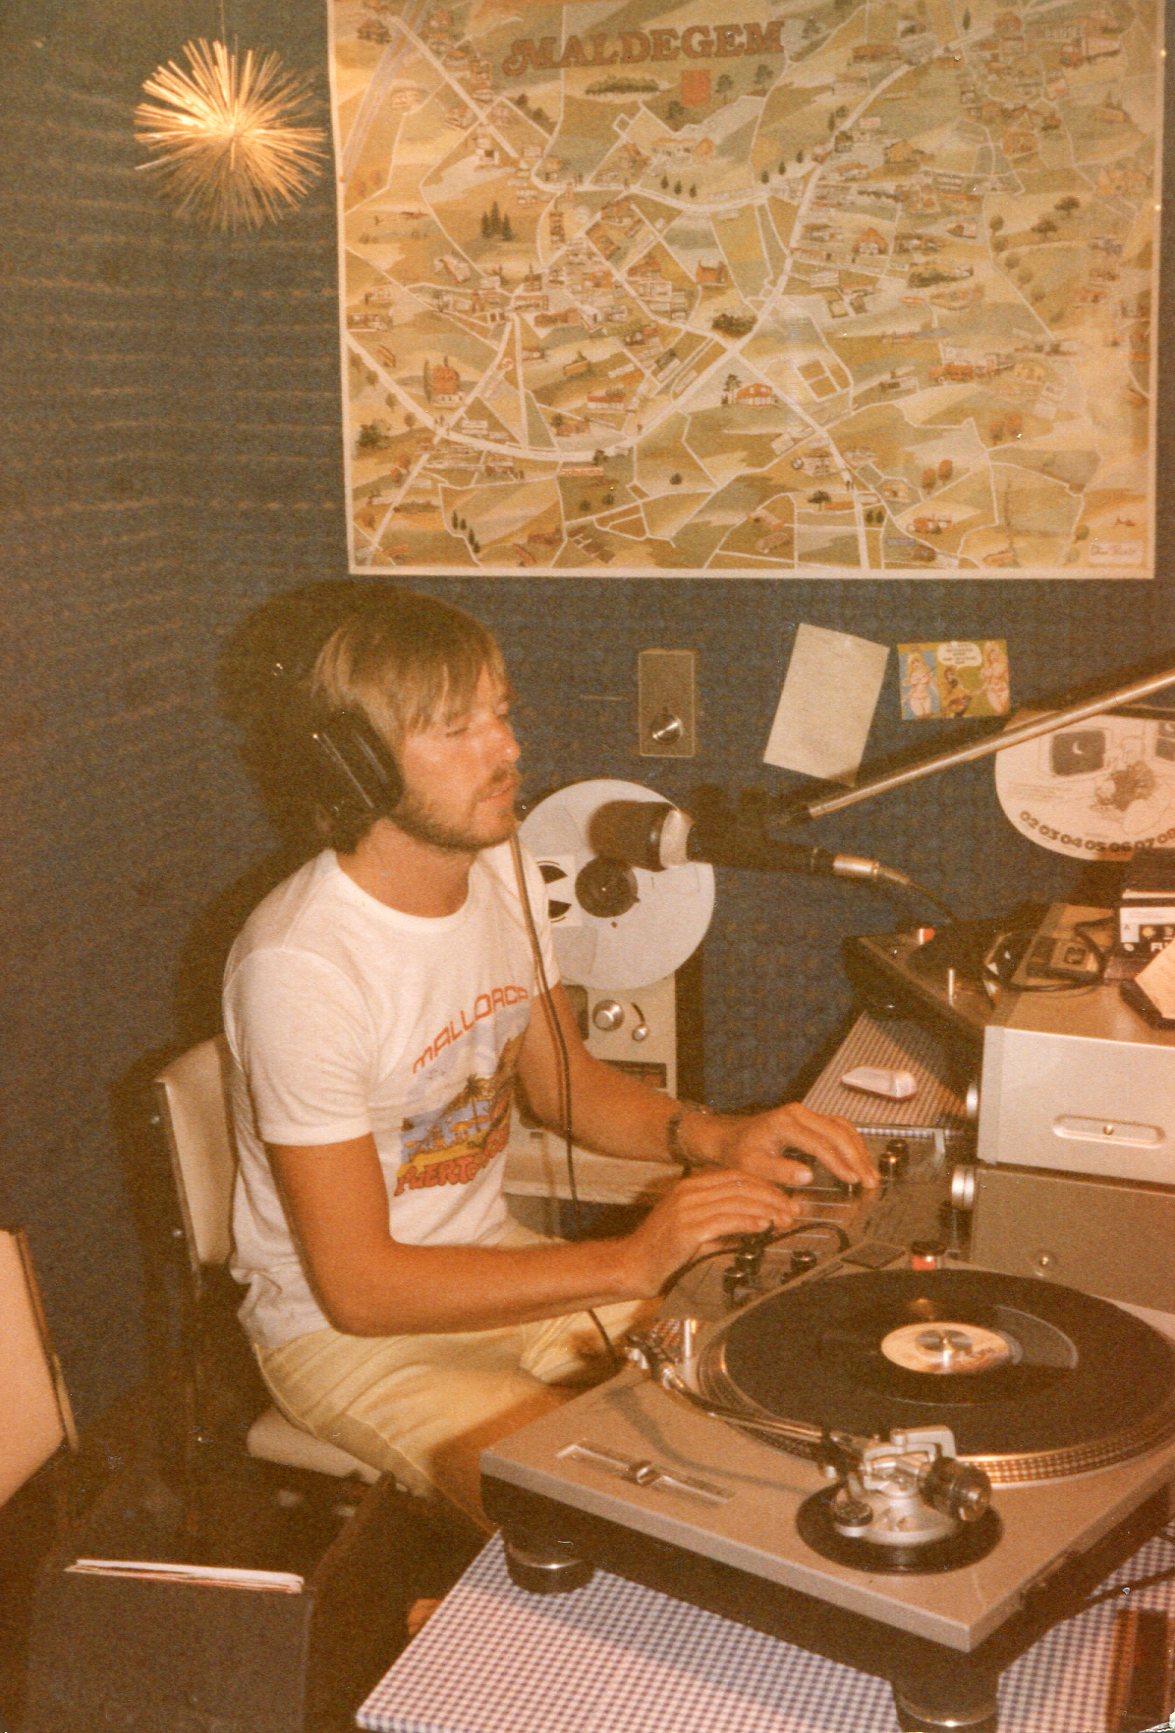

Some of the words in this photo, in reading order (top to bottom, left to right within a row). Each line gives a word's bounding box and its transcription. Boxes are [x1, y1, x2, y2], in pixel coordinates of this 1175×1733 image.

[502, 20, 785, 77] MALDEGEM
[1020, 811, 1039, 829] 02
[1039, 825, 1060, 840] 03
[1060, 834, 1082, 848] 04
[1085, 840, 1106, 852] 05
[412, 985, 529, 1074] MALLORCA
